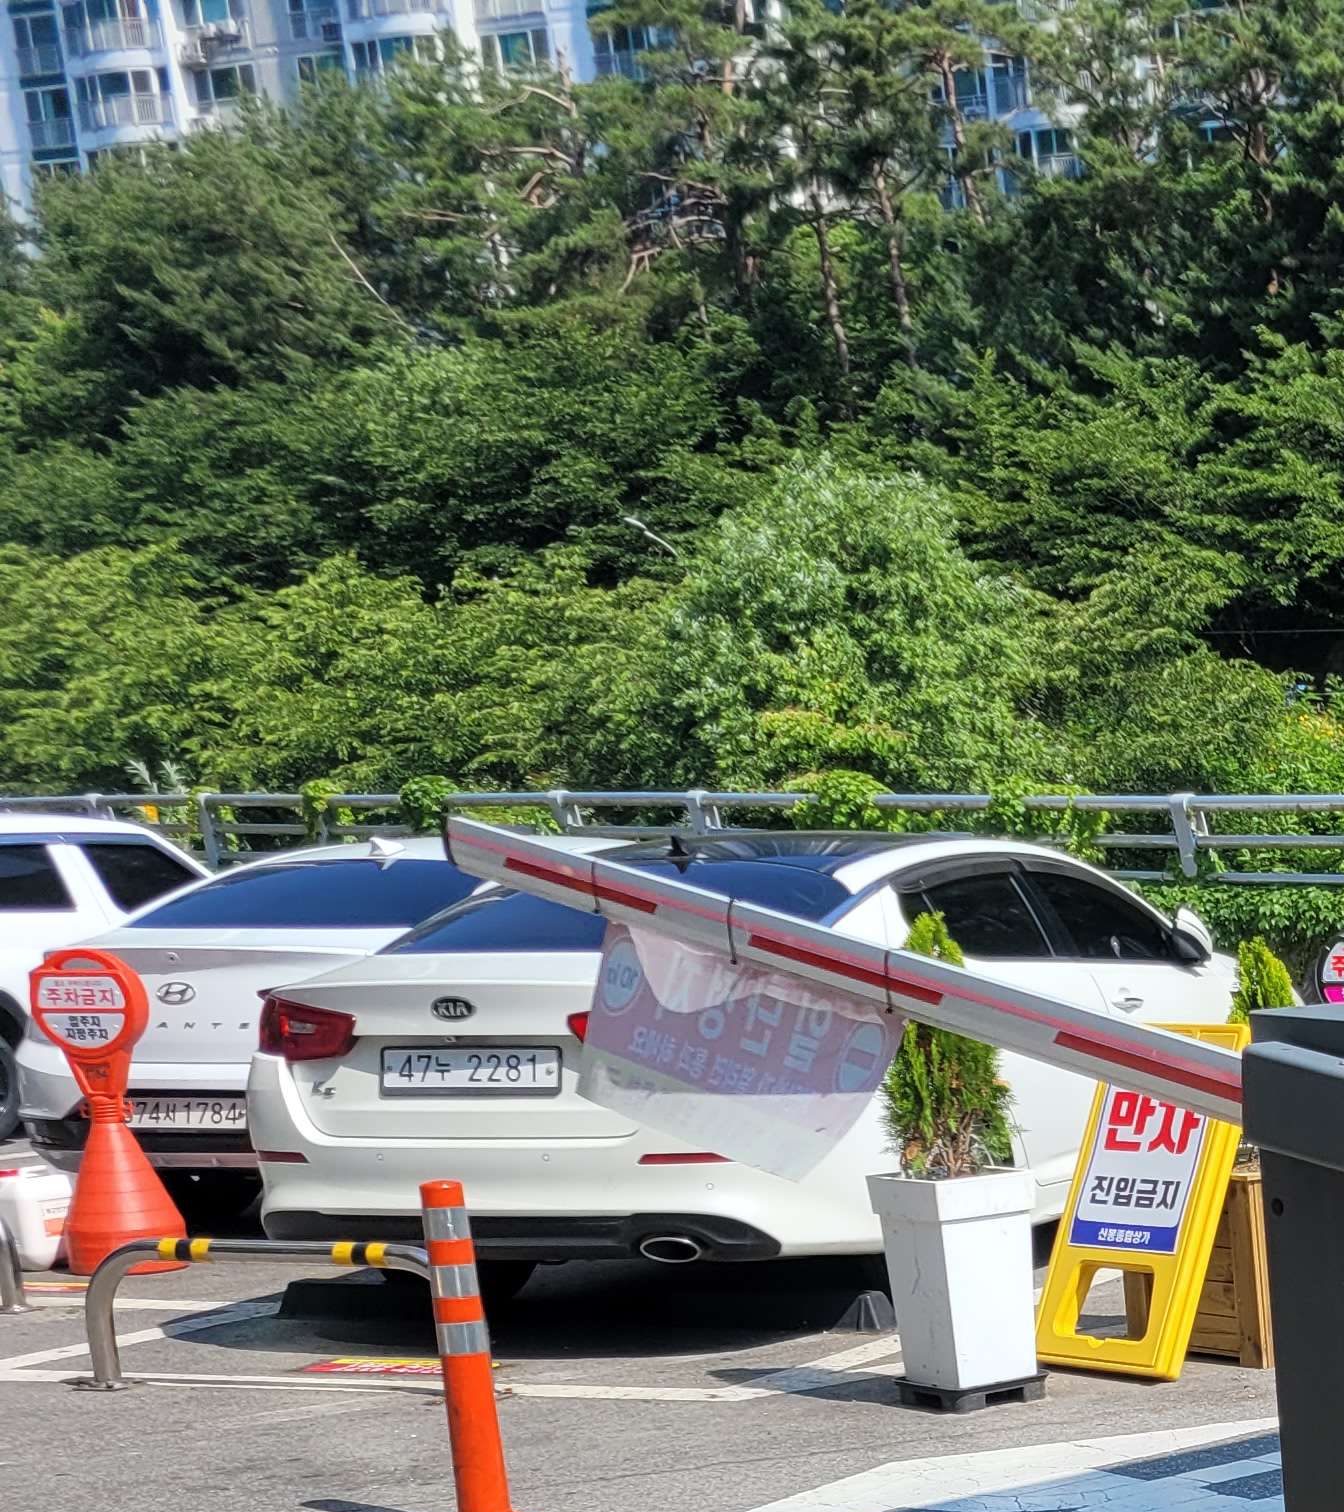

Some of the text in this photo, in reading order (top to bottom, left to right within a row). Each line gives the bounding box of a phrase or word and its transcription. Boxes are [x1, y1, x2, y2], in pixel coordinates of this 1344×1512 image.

[47, 988, 115, 1006] 주차금지
[437, 1002, 469, 1016] KIA
[399, 1054, 538, 1084] 47누 2281
[1089, 1175, 1181, 1210] 진입금지
[1098, 1227, 1151, 1245] 신봉종합상가
